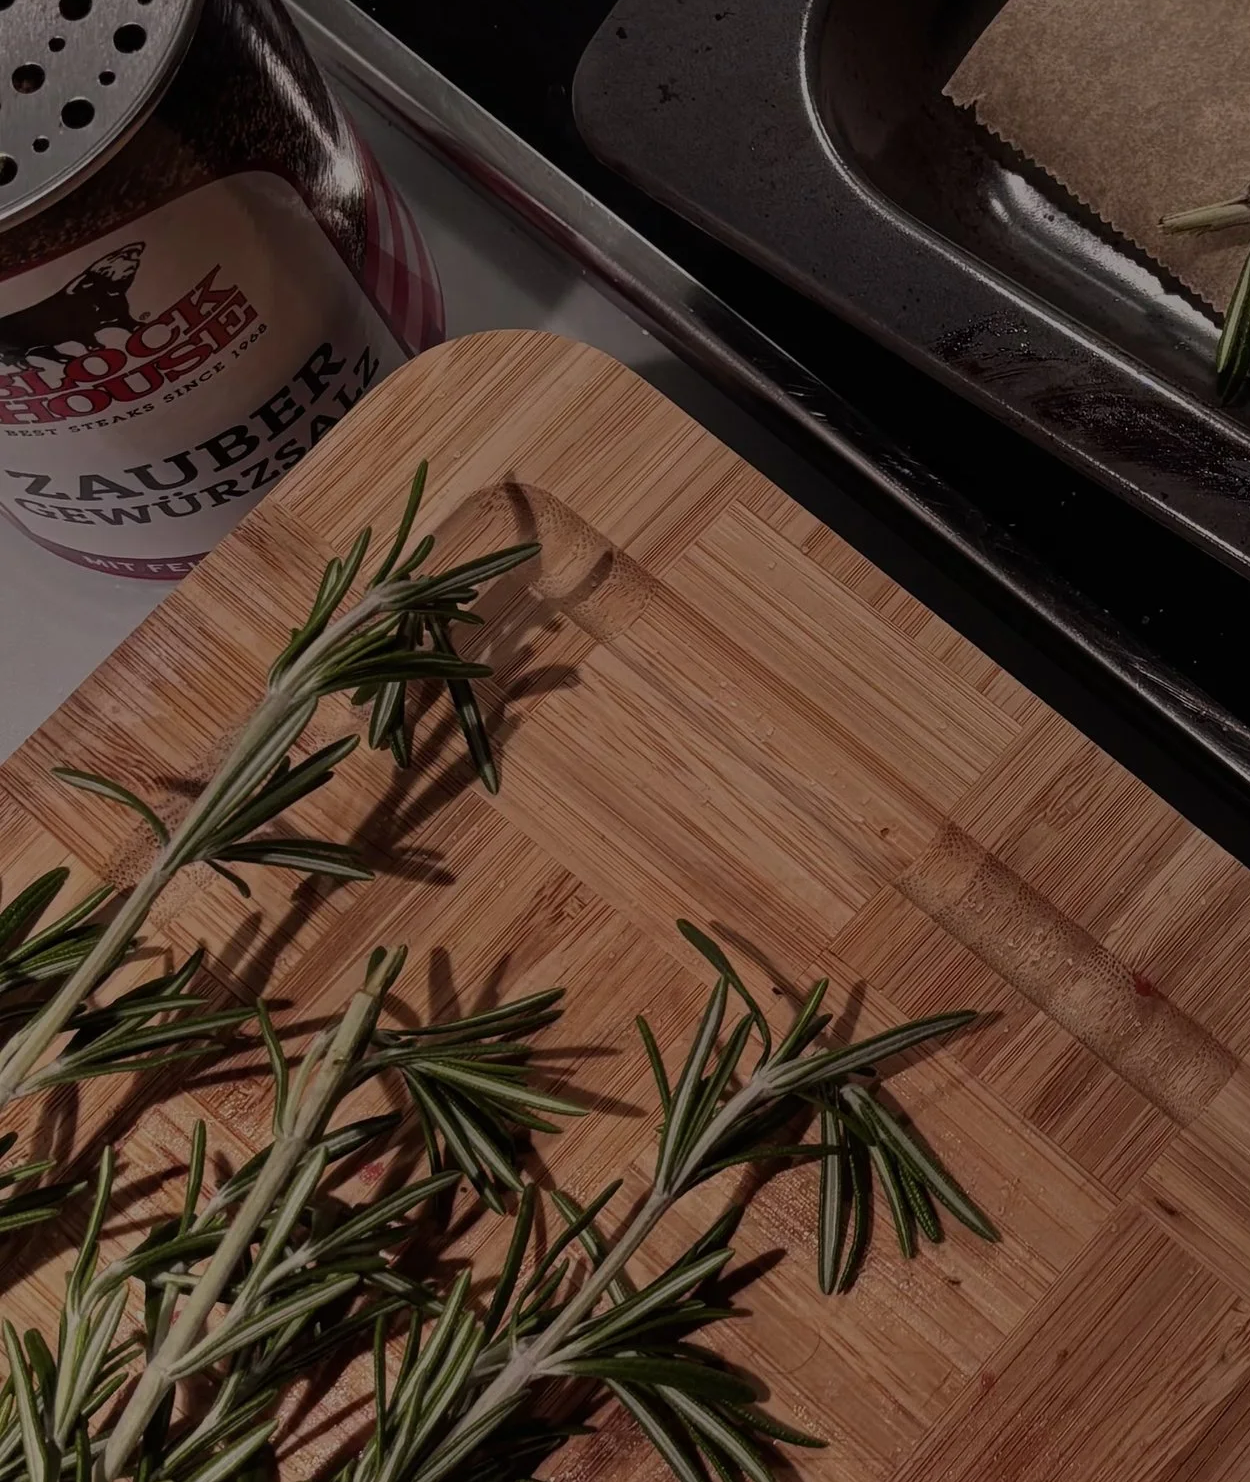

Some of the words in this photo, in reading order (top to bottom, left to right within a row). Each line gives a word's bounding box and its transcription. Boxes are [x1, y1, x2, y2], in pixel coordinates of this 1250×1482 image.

[0, 289, 259, 425] HOUSE
[4, 428, 58, 437] BEST
[68, 403, 155, 434] STEAKS
[163, 361, 226, 404] SINCE
[231, 322, 268, 360] 1968
[8, 341, 347, 502] ZAUBER
[14, 345, 380, 527] GEWÜRZSALZ
[82, 555, 135, 572] MIT
